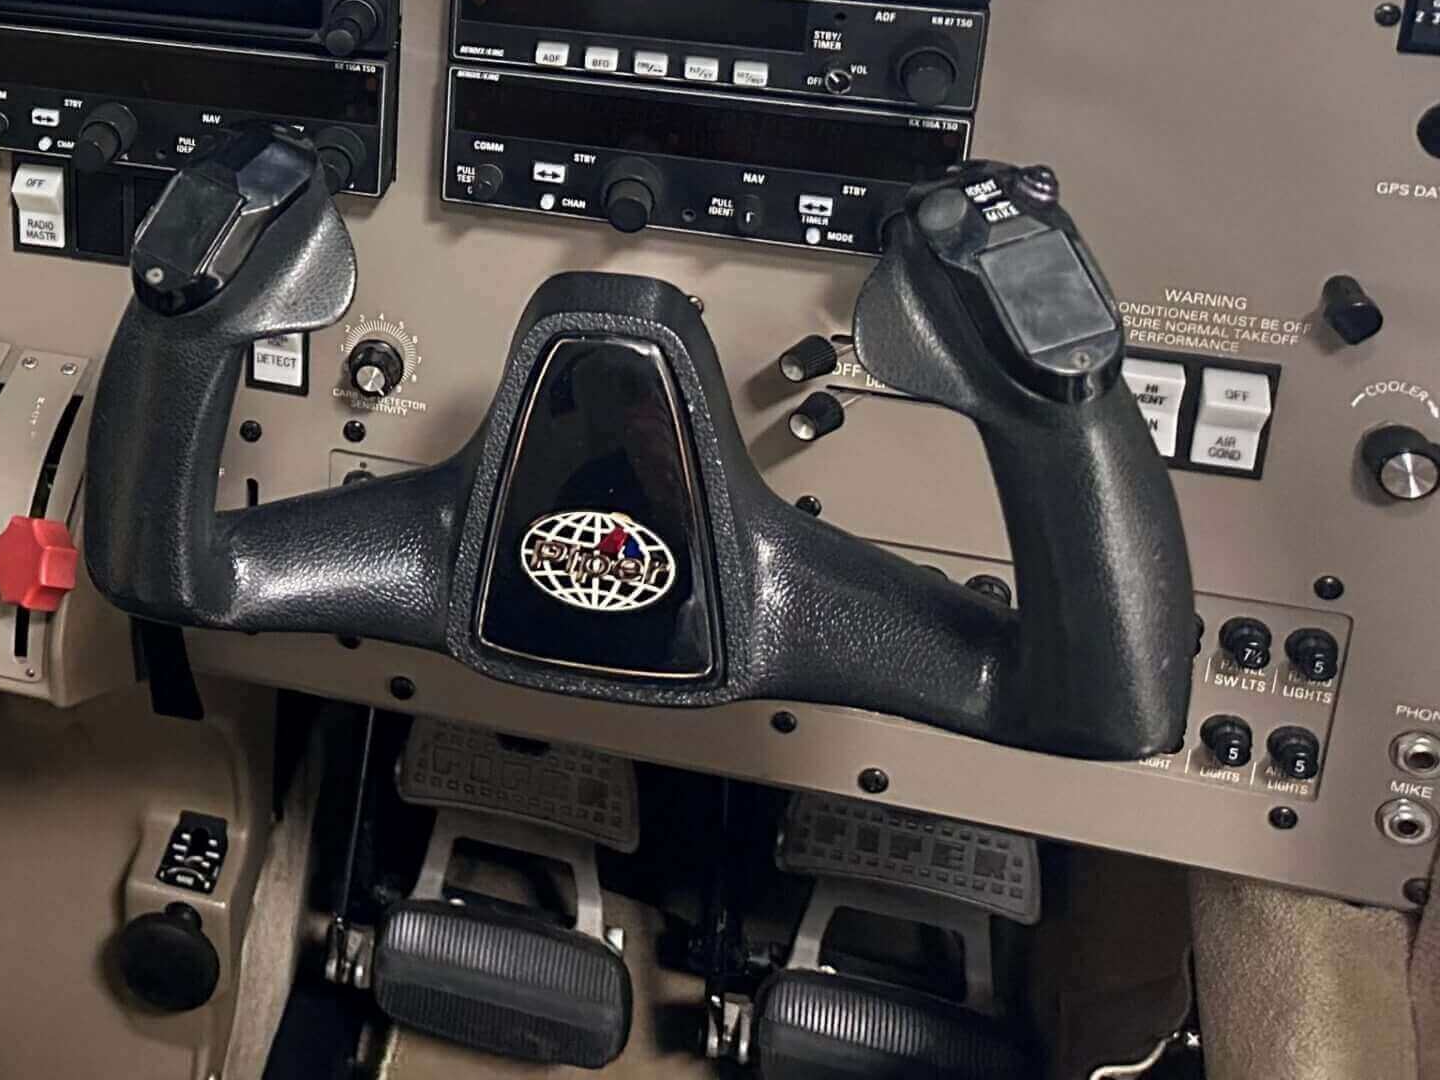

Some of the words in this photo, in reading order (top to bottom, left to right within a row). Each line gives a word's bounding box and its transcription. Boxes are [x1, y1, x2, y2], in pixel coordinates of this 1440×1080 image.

[875, 12, 896, 23] ADF
[957, 19, 972, 27] TSO
[814, 30, 842, 41] STBY/
[814, 40, 842, 50] TIMER
[808, 77, 822, 85] OFF
[850, 65, 868, 74] VOL
[64, 99, 83, 108] STBY
[202, 115, 220, 124] NAV
[178, 137, 195, 146] PULL
[474, 141, 504, 152] COMM
[574, 154, 596, 163] STBY
[457, 166, 475, 175] PULL
[26, 179, 45, 188] OFF
[743, 173, 765, 184] NAV
[843, 185, 866, 196] STBY
[1376, 182, 1409, 196] GPS
[562, 199, 586, 208] CHAN
[712, 198, 733, 207] PULL
[708, 207, 735, 216] IDENT
[985, 205, 1019, 222] MIKE
[28, 219, 54, 230] RADIO
[802, 215, 829, 225] TIMER
[27, 231, 57, 241] MASTR
[827, 232, 853, 242] MODE
[1165, 289, 1247, 310] WARNING
[1119, 302, 1208, 320] ONDITIONER
[1213, 313, 1256, 326] MUST
[1261, 318, 1280, 330] BE
[1283, 320, 1310, 334] OFF
[1165, 320, 1229, 338] NORMAL
[1234, 328, 1299, 345] TAKEOFF
[1130, 330, 1239, 352] PERFORMANCE
[257, 352, 296, 368] DETECT
[1146, 384, 1158, 392] HI
[1225, 389, 1249, 400] OFF
[1366, 381, 1428, 403] COOLER
[351, 400, 408, 416] SENSITIVITY
[1216, 436, 1235, 447] AIR
[1208, 447, 1241, 461] COND
[529, 536, 670, 585] Piper
[1215, 674, 1239, 687] SW
[1242, 678, 1266, 692] LTS
[1283, 686, 1333, 703] LIGHTS
[1200, 767, 1239, 782] LIGHTS
[1267, 781, 1309, 795] LIGHTS
[1390, 781, 1433, 798] MIKE
